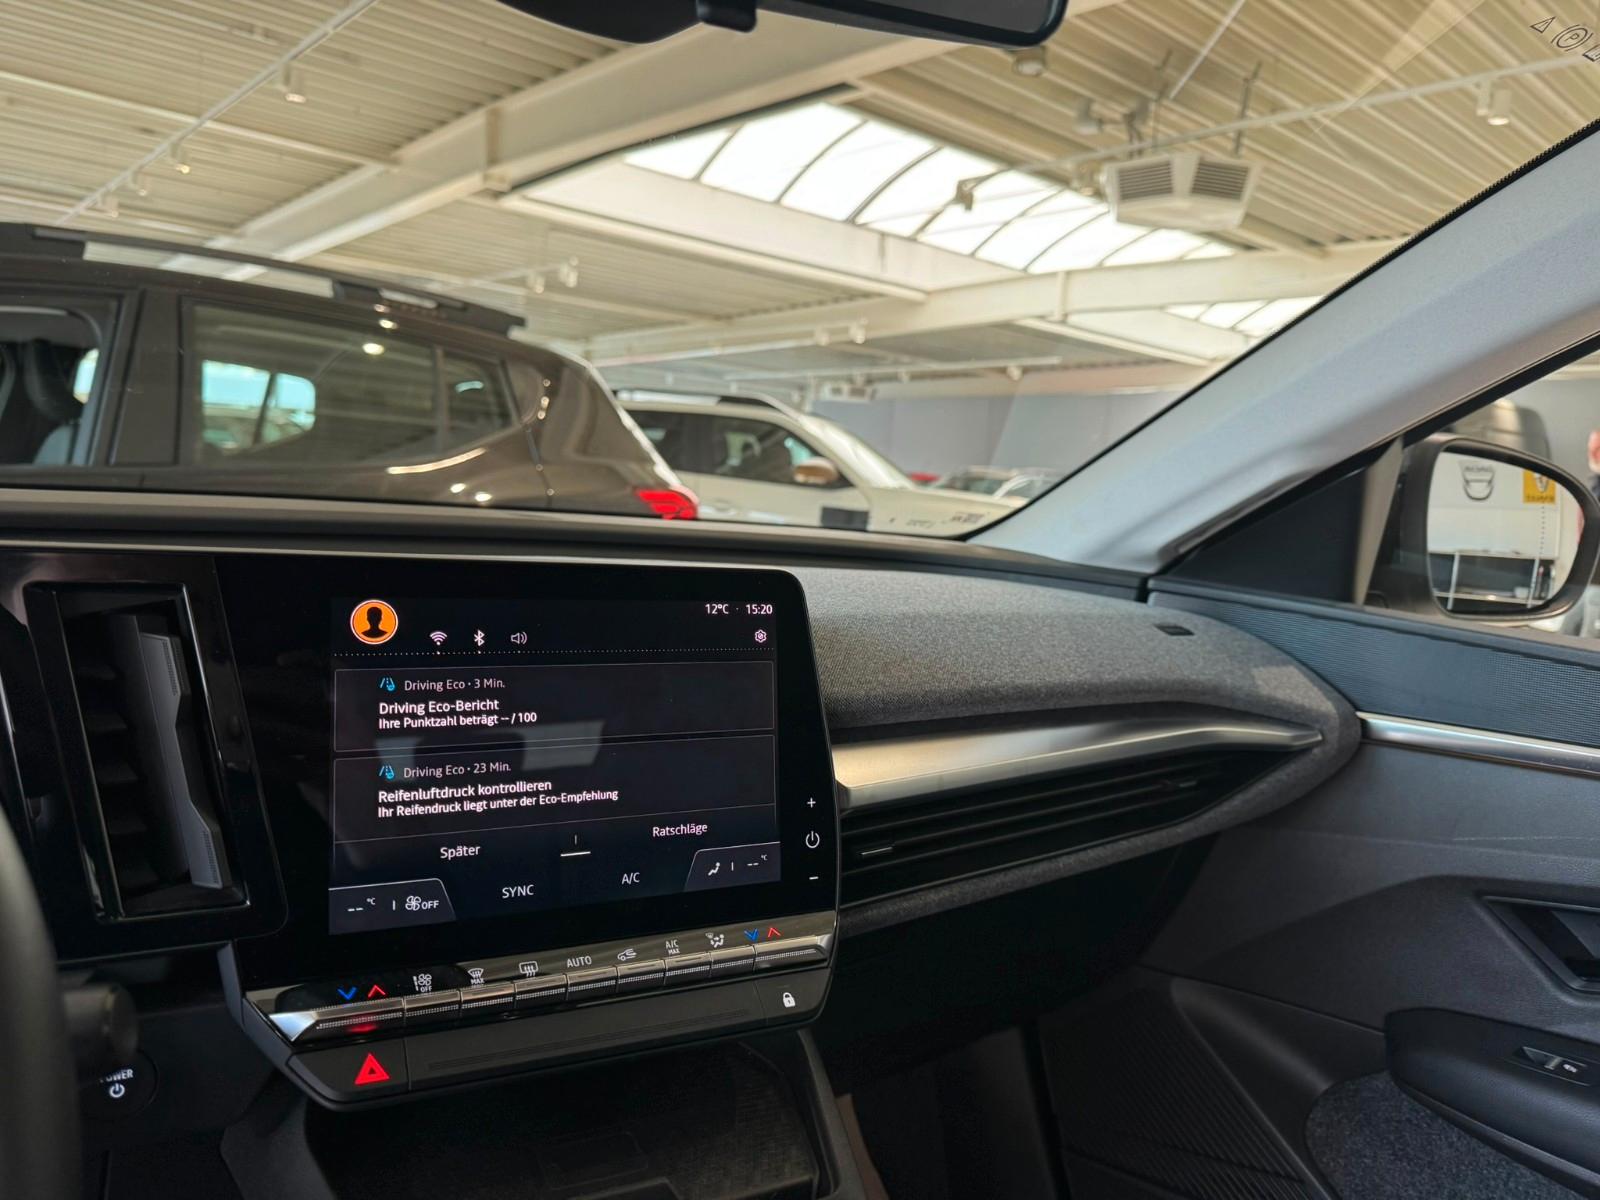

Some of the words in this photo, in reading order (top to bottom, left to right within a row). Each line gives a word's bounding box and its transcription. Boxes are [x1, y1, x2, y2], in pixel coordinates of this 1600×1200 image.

[745, 603, 773, 615] 15:20
[404, 680, 444, 692] Driving
[446, 679, 466, 690] Eco
[473, 678, 481, 689] 3
[483, 678, 506, 689] Min.
[378, 702, 426, 715] Driving
[428, 699, 500, 713] Eco-Bericht
[378, 718, 401, 729] Ihre
[403, 716, 458, 729] Punktzahl
[459, 714, 499, 728] beträgt
[518, 712, 538, 723] 100
[403, 767, 443, 778] Driving
[445, 765, 465, 776] Eco
[473, 762, 487, 774] 23
[489, 761, 512, 773] Min.
[378, 785, 476, 803] Reifenluftdruck
[478, 781, 552, 796] kontrollieren
[378, 806, 394, 818] Ihr
[396, 801, 462, 817] Reifendruck
[463, 799, 488, 812] liegt
[489, 799, 519, 809] unter
[520, 796, 537, 807] der
[539, 790, 619, 805] Eco-Empfehlung
[652, 823, 708, 838] Ratschläge
[440, 845, 481, 860] Später
[621, 872, 641, 885] A/C
[502, 884, 535, 899] SYNC
[421, 900, 440, 910] OFF
[665, 939, 679, 950] A/C
[566, 955, 593, 969] AUTO
[420, 985, 433, 993] OFF
[100, 1068, 134, 1082] OWER
